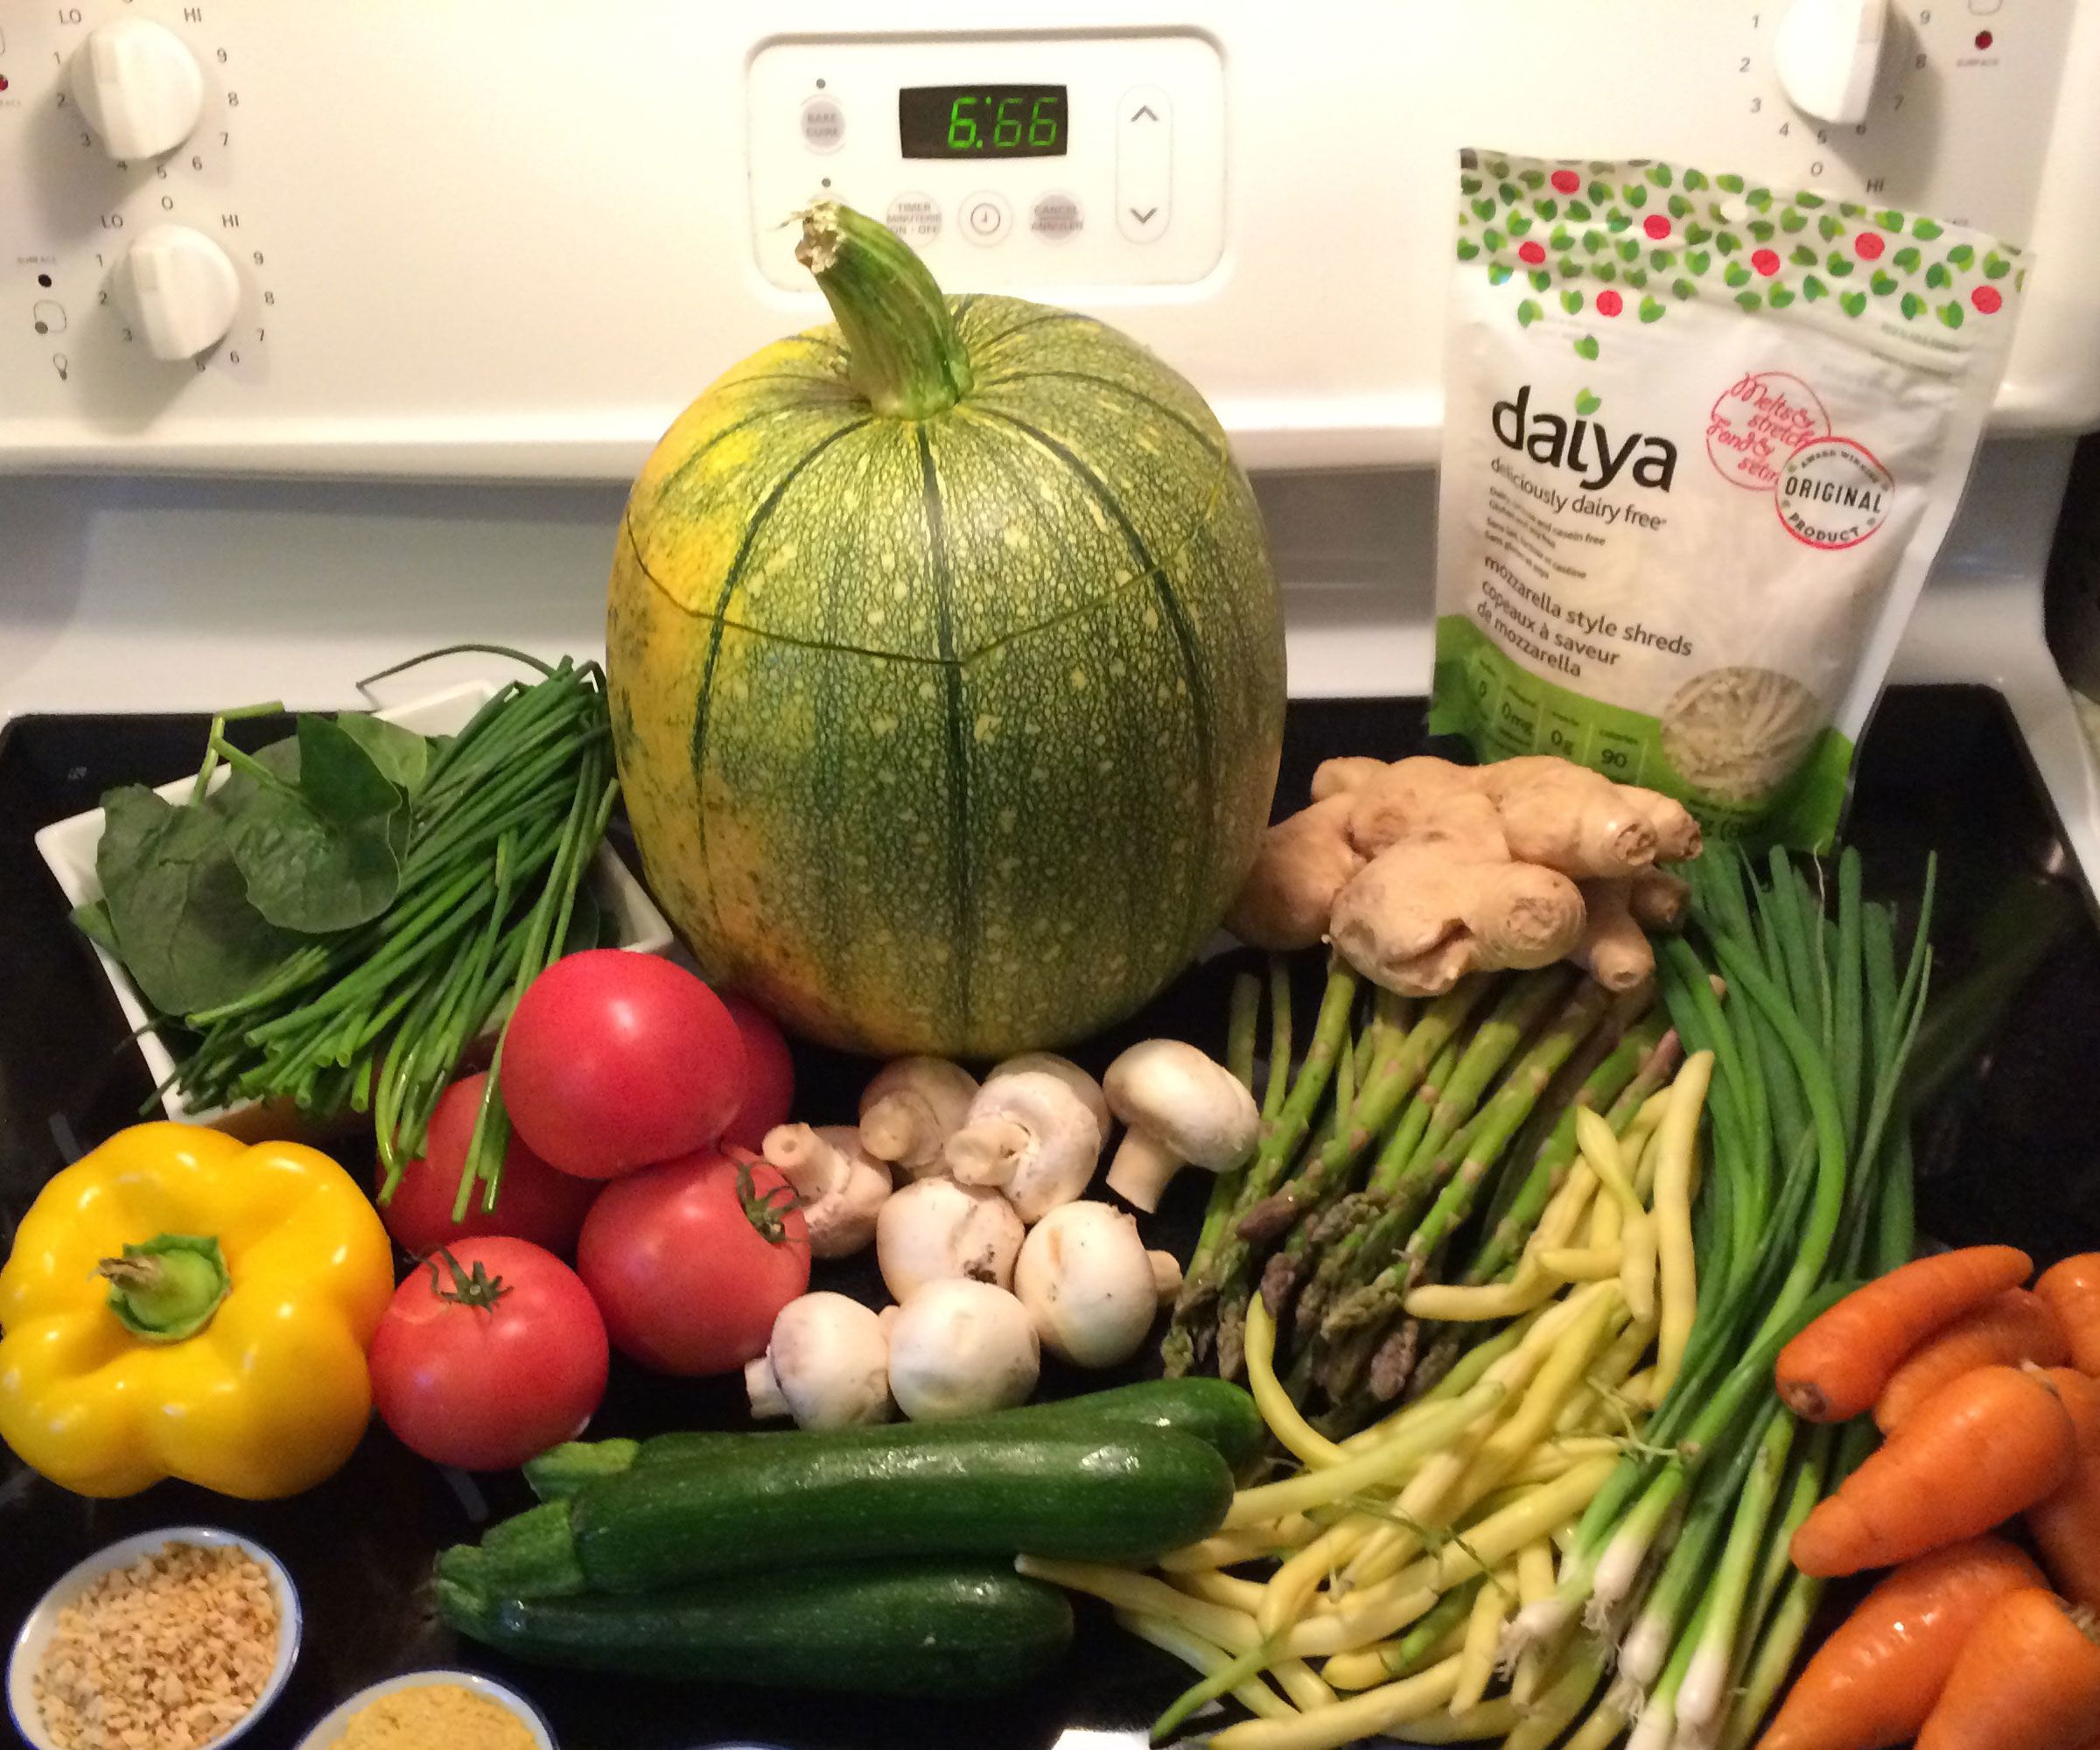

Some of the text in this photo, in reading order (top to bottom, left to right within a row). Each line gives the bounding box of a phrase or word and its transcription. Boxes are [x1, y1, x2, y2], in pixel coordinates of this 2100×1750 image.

[59, 9, 82, 24] LO
[184, 8, 202, 22] HI
[1752, 15, 1759, 29] 1
[1920, 10, 1931, 24] 9
[53, 51, 61, 64] 1
[217, 47, 228, 63] 9
[1739, 57, 1751, 73] 2
[57, 93, 66, 108] 2
[228, 91, 239, 107] 8
[1750, 98, 1761, 113] 3
[1892, 94, 1905, 110] 7
[1779, 122, 1789, 136] 4
[82, 133, 91, 147] 3
[220, 132, 229, 146] 7
[192, 156, 202, 171] 6
[1866, 178, 1885, 192] HI
[101, 214, 123, 228] LO
[221, 214, 239, 228] HI
[95, 254, 103, 266] 1
[253, 250, 263, 265] 9
[98, 290, 107, 305] 2
[264, 290, 275, 305] 8
[122, 327, 132, 342] 3
[256, 328, 264, 341] 7
[229, 351, 240, 364] 6
[1492, 385, 1677, 493] daiya
[1491, 458, 1569, 514] deliciously
[1572, 494, 1620, 525] dairy
[1785, 476, 1882, 514] ORIGINAL
[1788, 512, 1859, 542] PRODUCT
[1484, 556, 1693, 656] mozzarella style shreds
[1482, 581, 1535, 633] copeaux
[1554, 634, 1621, 665] saveur
[1477, 601, 1492, 622] de
[1494, 618, 1581, 678] mozzarella
[1601, 748, 1628, 768] 90
